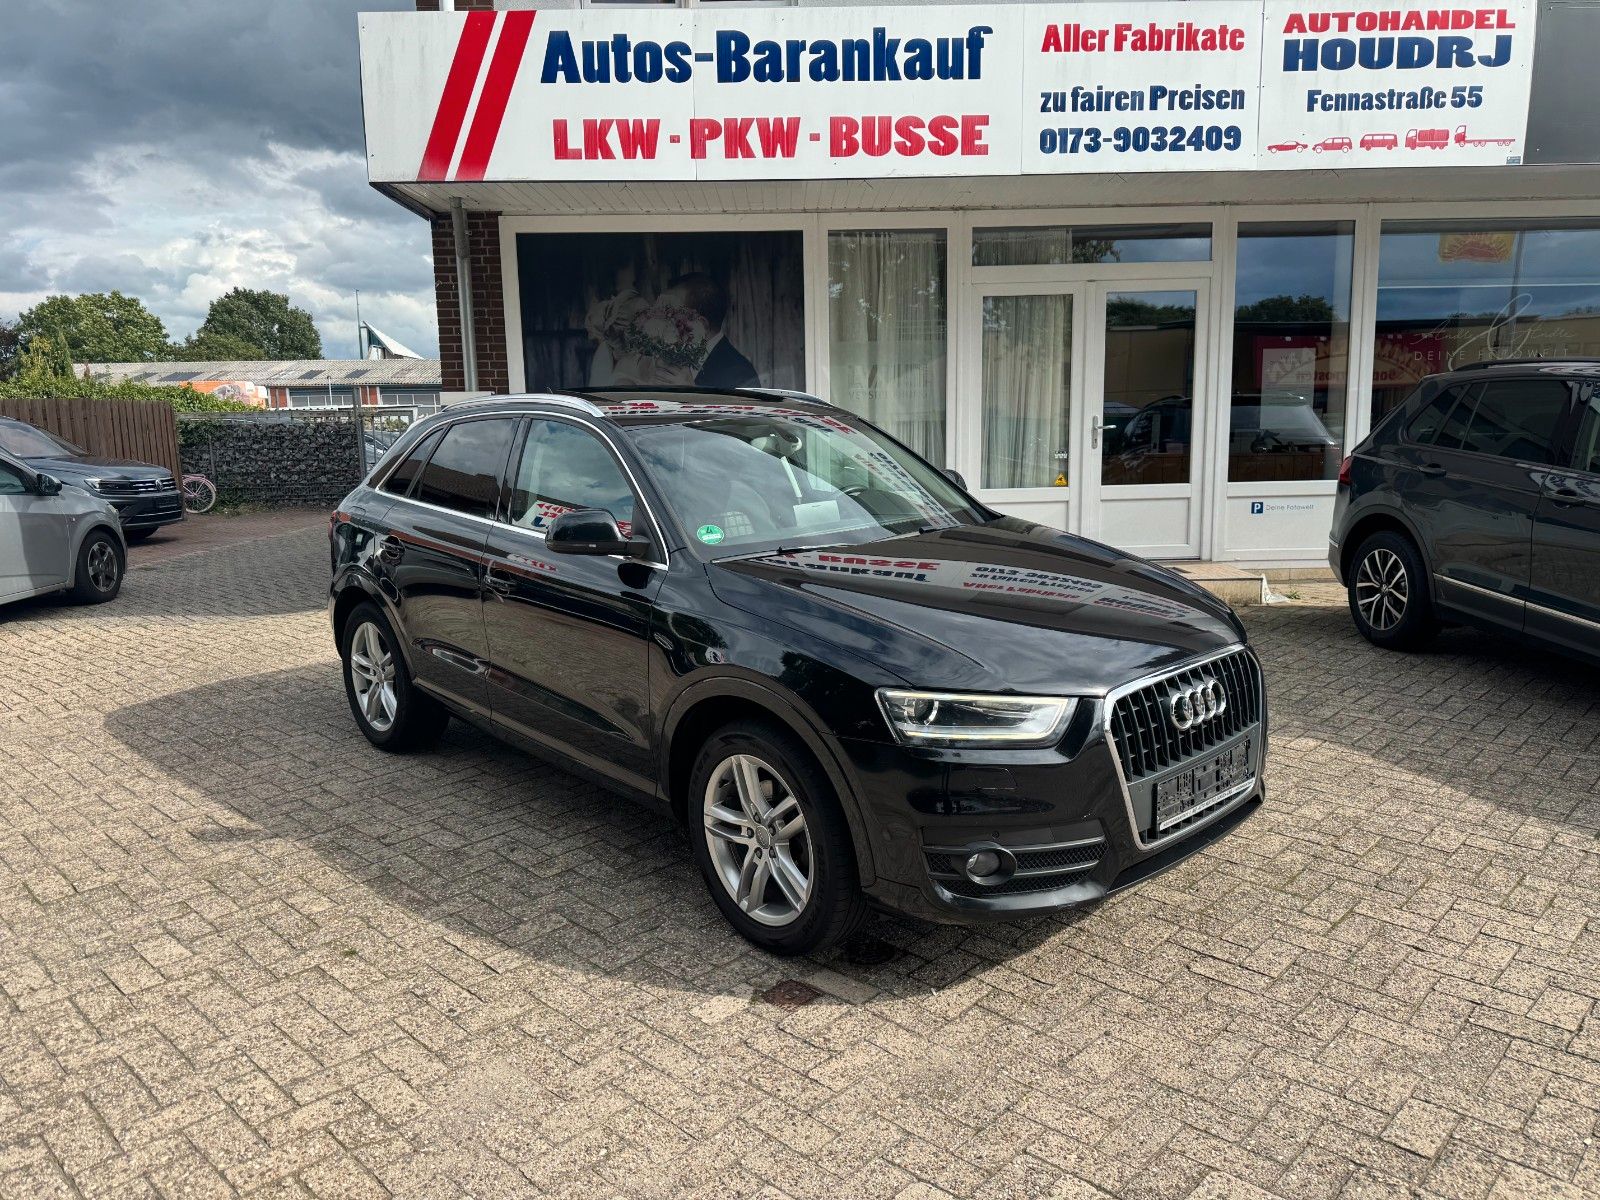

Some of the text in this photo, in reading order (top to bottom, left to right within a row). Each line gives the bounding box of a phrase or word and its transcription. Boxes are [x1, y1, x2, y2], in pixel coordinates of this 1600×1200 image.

[1283, 9, 1516, 34] AUTOHANDEL
[1041, 22, 1245, 53] Aller Fabrikate
[541, 26, 993, 84] Autos-Barankauf
[1283, 35, 1512, 72] HOUDRJ
[1040, 84, 1245, 113] zu fairen Preisen
[1306, 86, 1483, 112] Fennastraße 55
[553, 115, 990, 161] LKW PKW BUSSE
[1039, 125, 1242, 154] 0173-9032409
